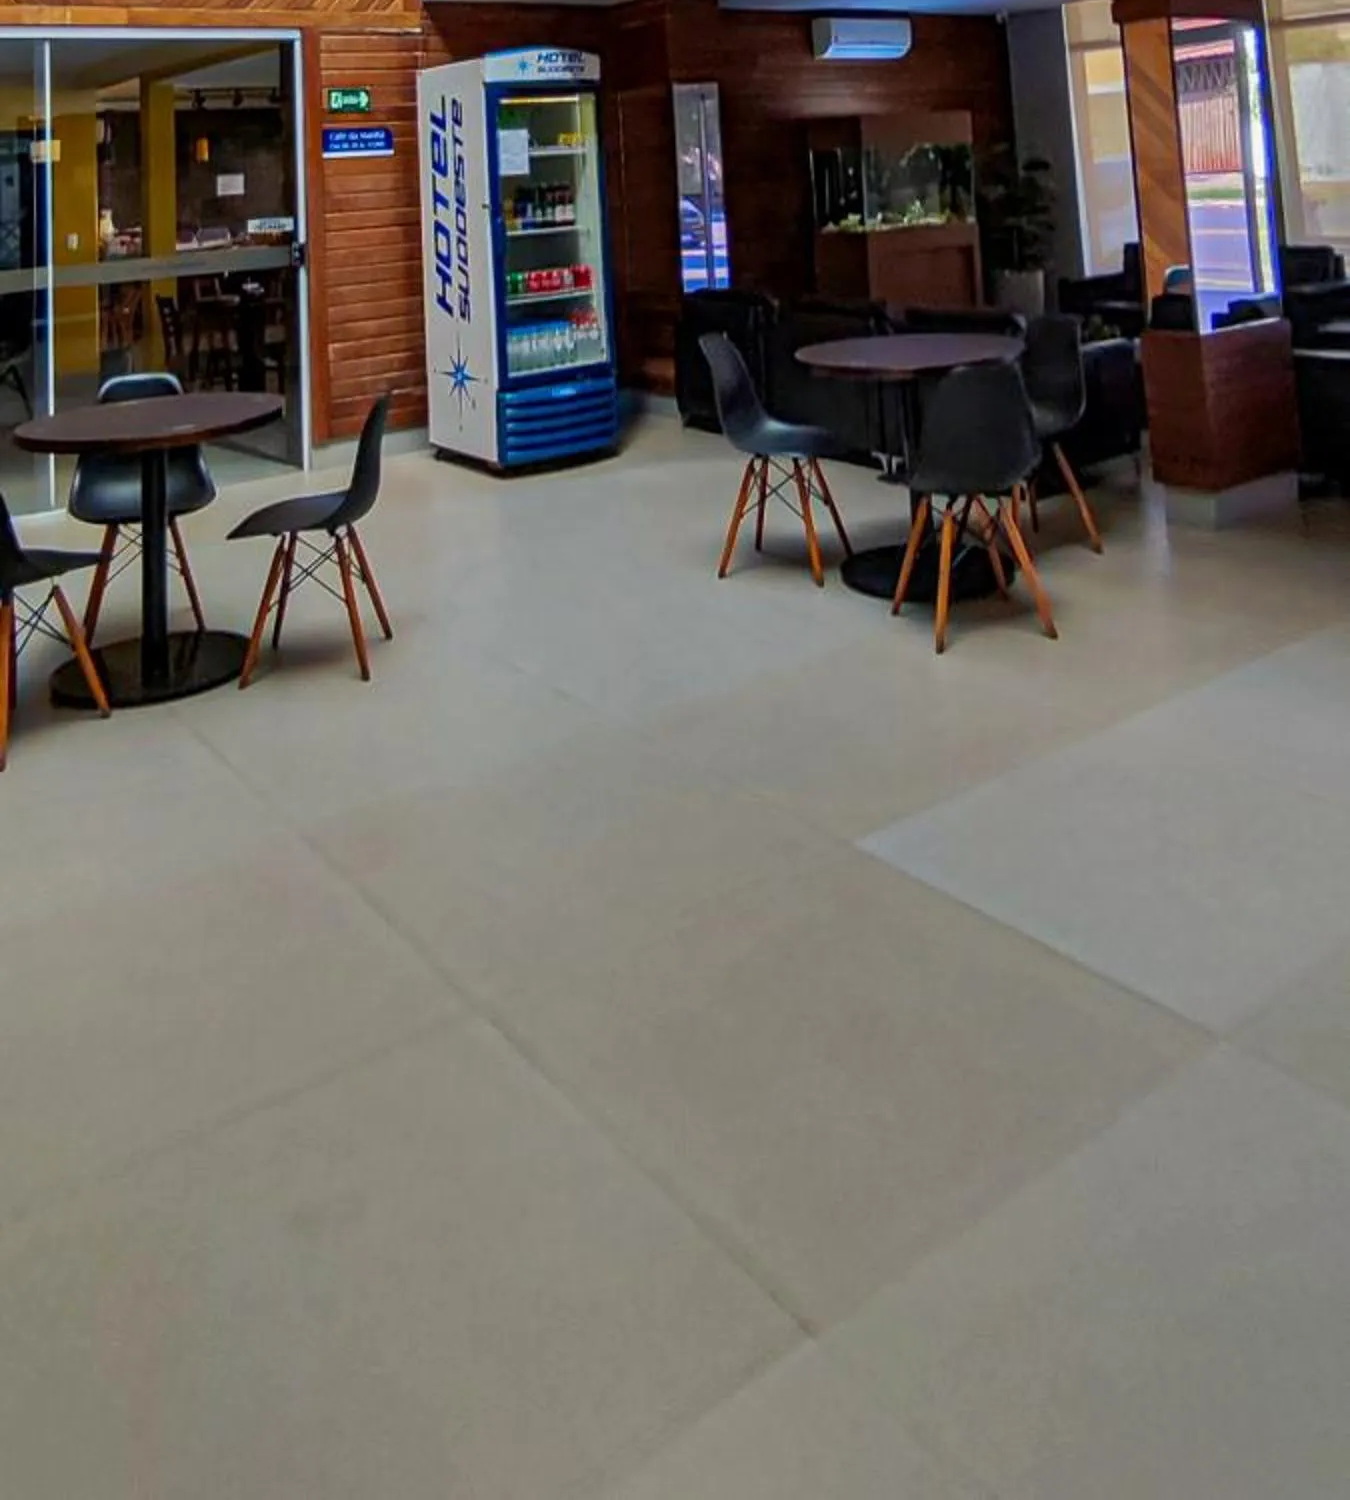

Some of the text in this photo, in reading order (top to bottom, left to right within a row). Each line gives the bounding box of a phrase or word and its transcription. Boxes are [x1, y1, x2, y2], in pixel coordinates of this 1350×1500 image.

[537, 52, 583, 62] HOTEL
[430, 94, 455, 319] HOTEL
[451, 97, 471, 325] SUDOESTE
